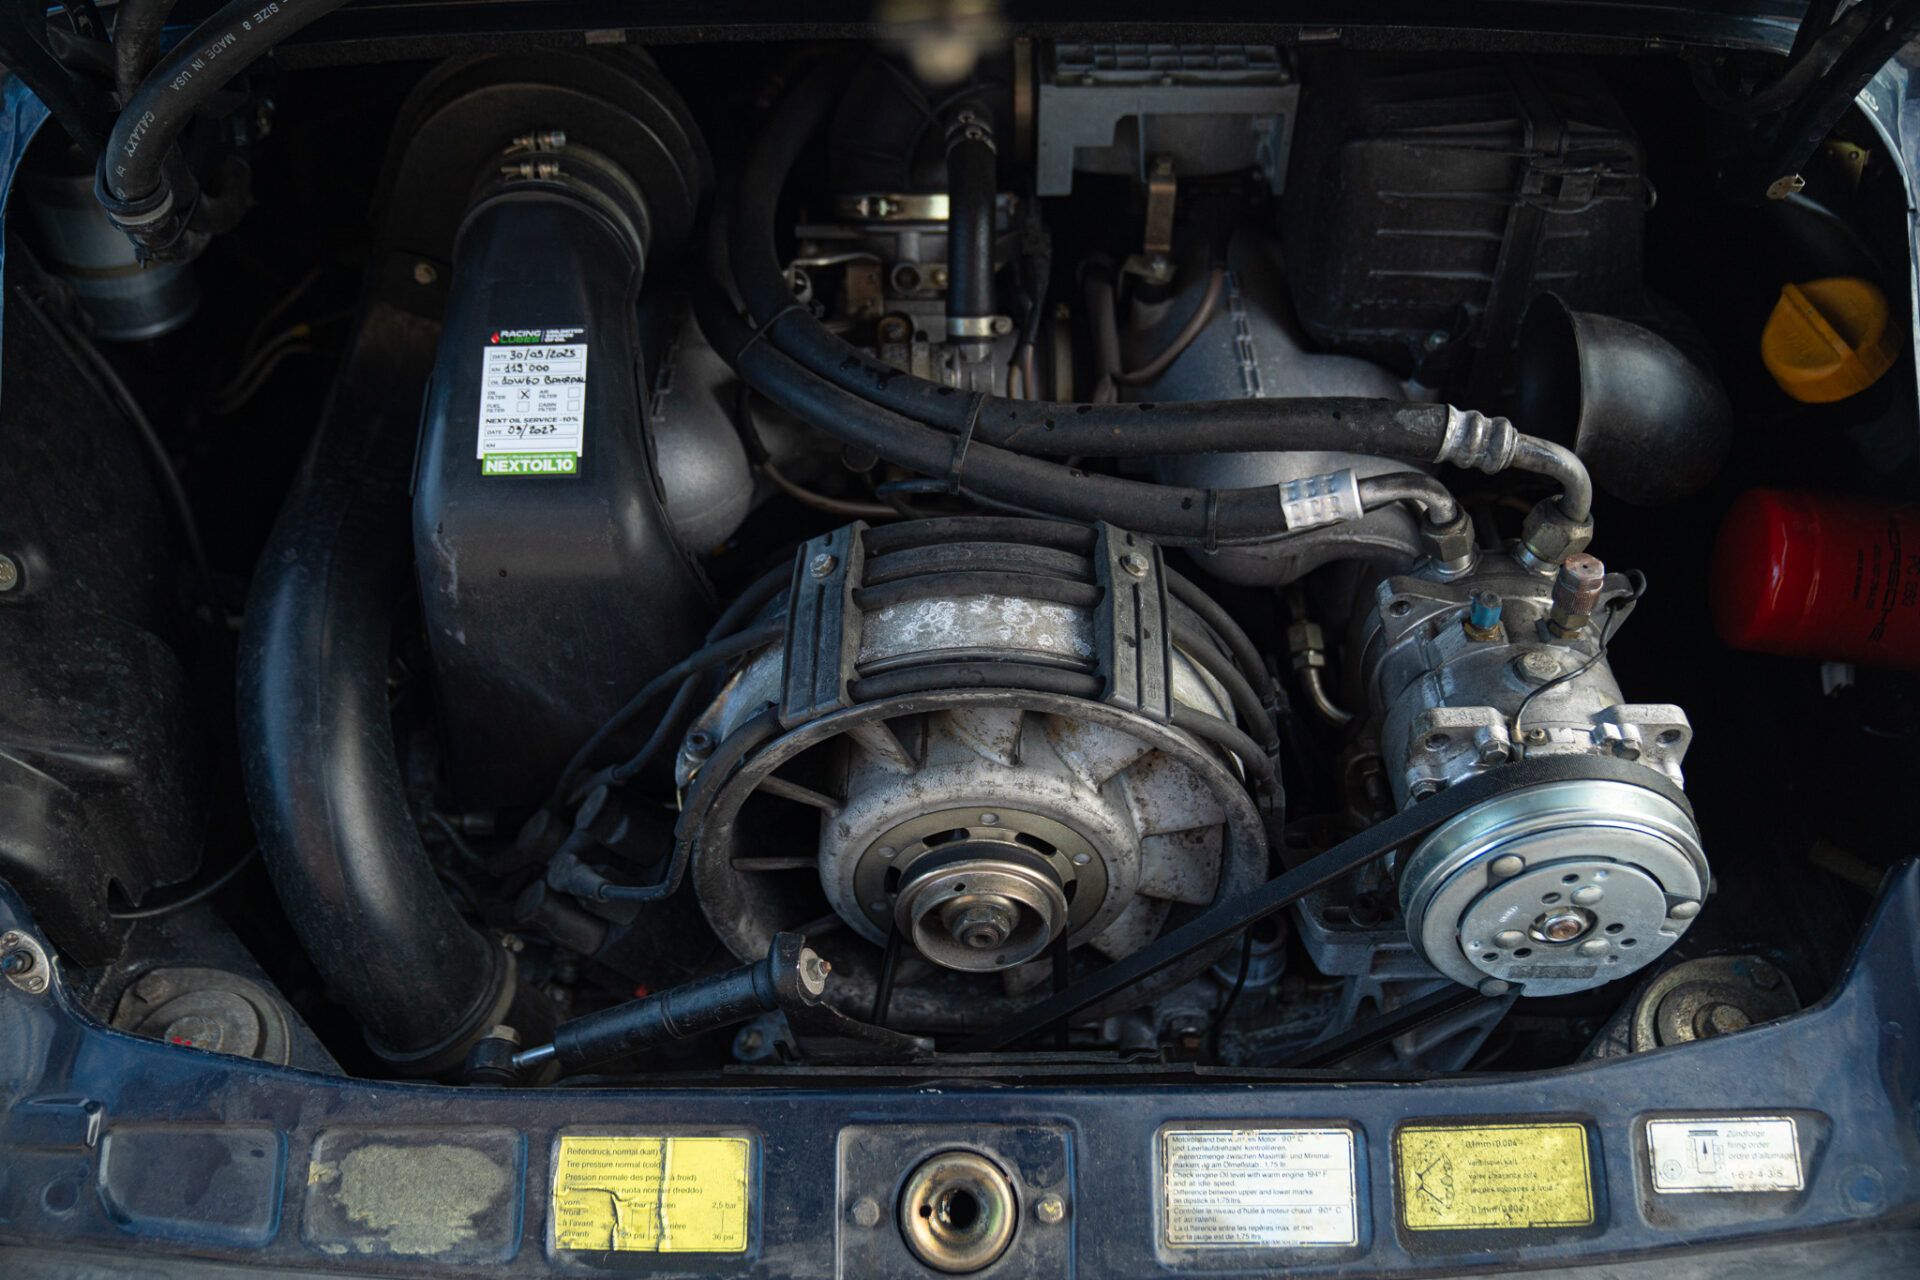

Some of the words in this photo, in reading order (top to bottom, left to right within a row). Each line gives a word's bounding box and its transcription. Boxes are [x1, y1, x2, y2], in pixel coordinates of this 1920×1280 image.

[253, 2, 280, 24] SIZE
[242, 20, 252, 31] 8
[207, 32, 237, 60] MADE
[191, 57, 206, 72] IN
[170, 70, 192, 91] USA
[124, 110, 156, 158] GALAXY
[486, 459, 573, 472] NEXTOIL10
